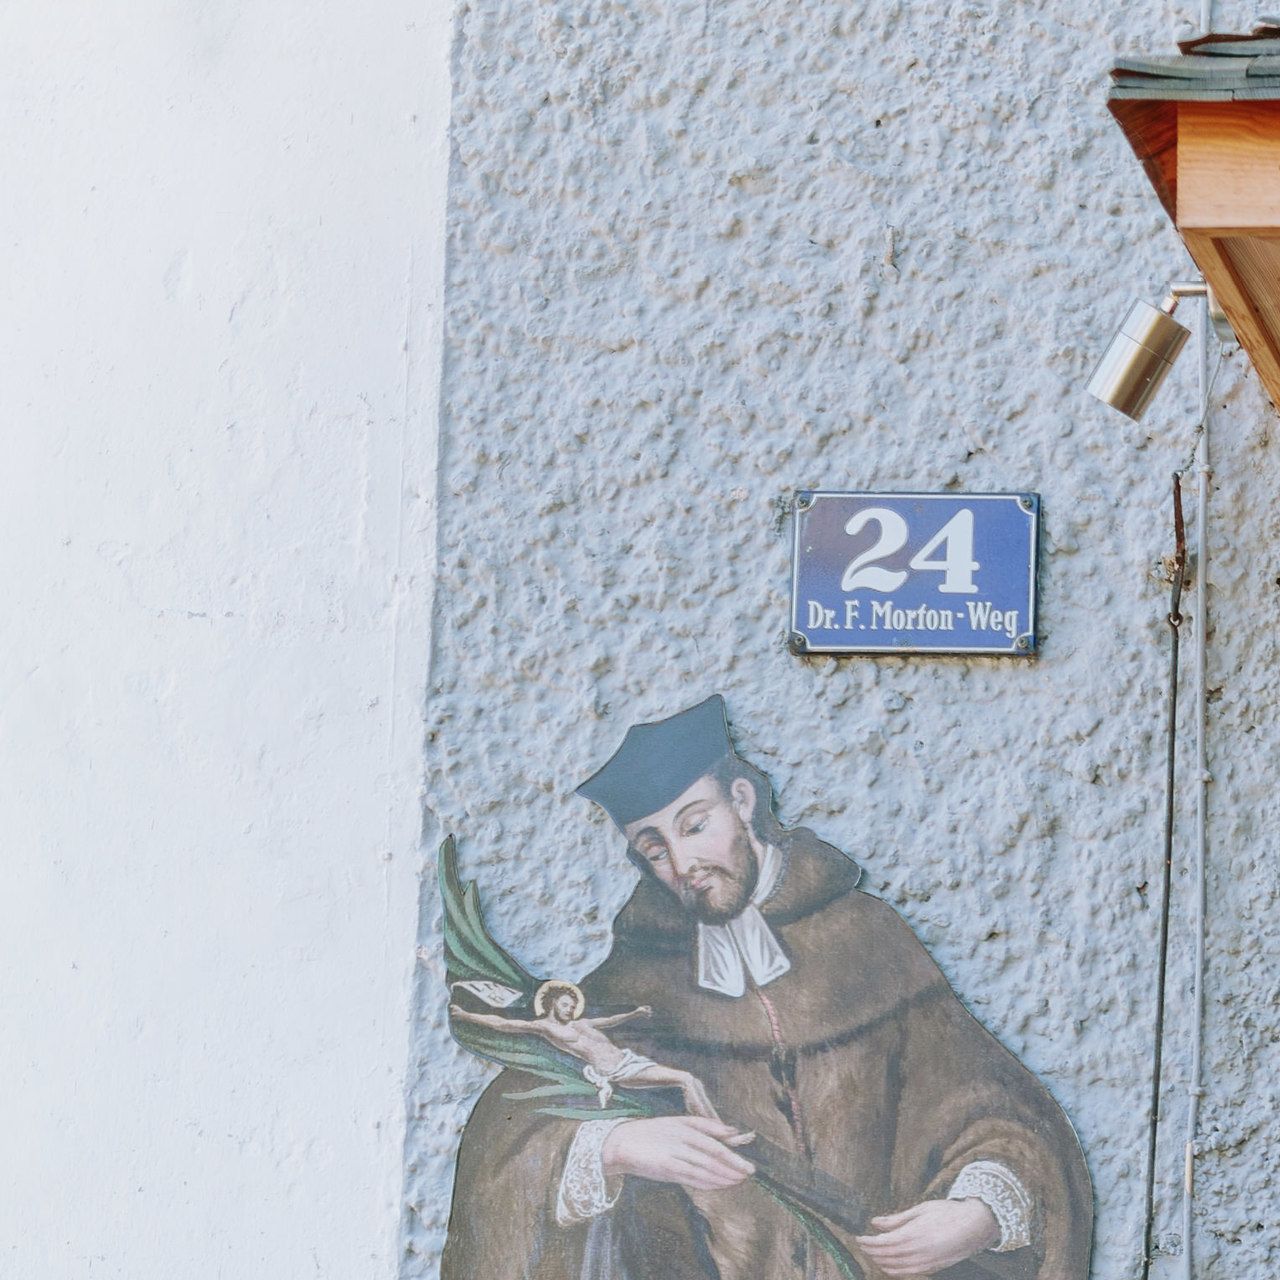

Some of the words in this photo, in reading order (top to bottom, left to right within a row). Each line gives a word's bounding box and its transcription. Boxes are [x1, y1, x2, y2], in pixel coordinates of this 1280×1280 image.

[841, 507, 980, 593] 24
[807, 600, 839, 630] Dr.
[845, 600, 865, 631] F.
